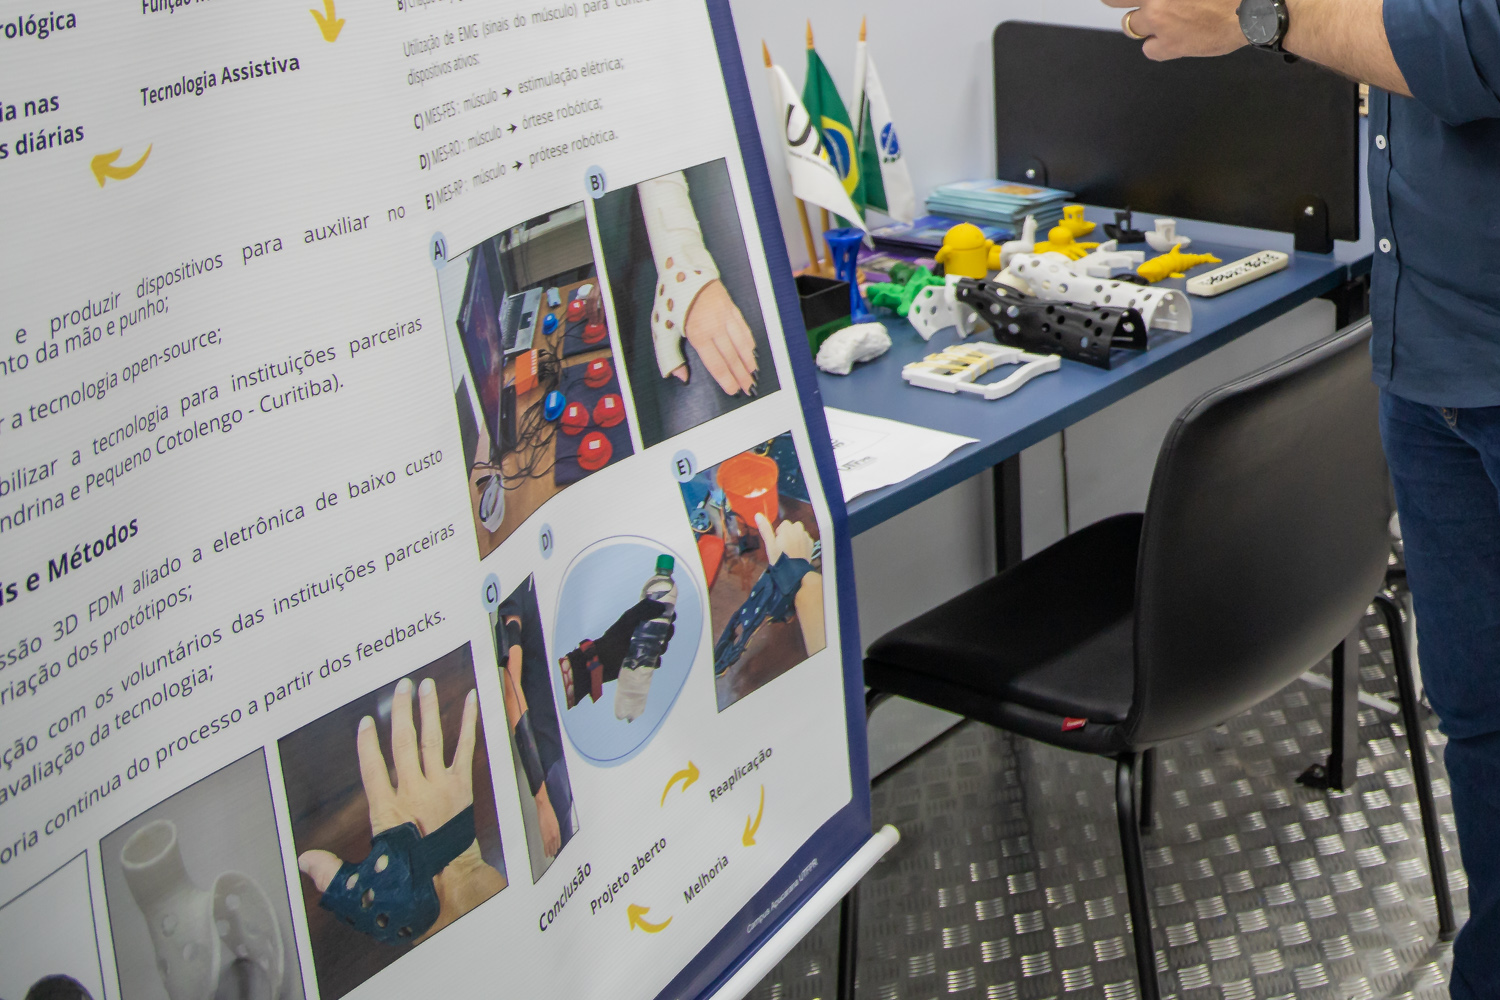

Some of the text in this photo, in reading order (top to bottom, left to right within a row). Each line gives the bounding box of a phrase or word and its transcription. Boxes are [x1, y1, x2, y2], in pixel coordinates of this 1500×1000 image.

[402, 32, 441, 57] Utilização
[457, 22, 480, 43] EMG
[513, 13, 527, 29] do
[531, 1, 578, 25] músculo)
[140, 55, 301, 107] Tecnologia Assistiva
[406, 59, 452, 87] dispositivos
[463, 87, 499, 113] músculo
[517, 66, 579, 95] estimulação
[24, 93, 61, 118] nas
[467, 124, 502, 151] músculo
[521, 110, 555, 131] órtese
[15, 123, 86, 156] diárias
[472, 162, 507, 188] músculo
[528, 140, 569, 169] prótese
[571, 128, 620, 153] robótica.
[589, 173, 606, 193] B)
[50, 204, 407, 340] produzir dispositivos para auxiliar no
[434, 237, 447, 262] A)
[64, 296, 170, 354] mão punho;
[29, 327, 223, 424] tecnologia open-source;
[92, 317, 424, 457] tecnologia para instituições parceiras
[85, 446, 152, 495] Pequeno
[155, 407, 244, 456] Cotolengo
[259, 372, 345, 414] Curitiba).
[676, 457, 693, 477] E)
[48, 517, 140, 584] Métodos
[53, 448, 444, 643] 3D FDM aliado eletrônica de baixo custo
[486, 580, 499, 605] C)
[48, 521, 456, 740] com voluntários das instituições parceiras
[66, 638, 99, 669] dos
[103, 584, 194, 654] protótipos;
[44, 773, 123, 837] continua
[126, 756, 151, 782] do
[156, 707, 243, 770] processo
[263, 670, 314, 712] partir
[318, 651, 353, 680] dos
[355, 608, 447, 662] feedbacks.
[90, 722, 111, 748] da
[114, 663, 215, 732] tecnologia;
[708, 745, 774, 804] Reaplicação
[537, 861, 593, 933] Conclusão
[589, 835, 668, 916] Projeto aberto
[682, 853, 730, 905] Melhoria
